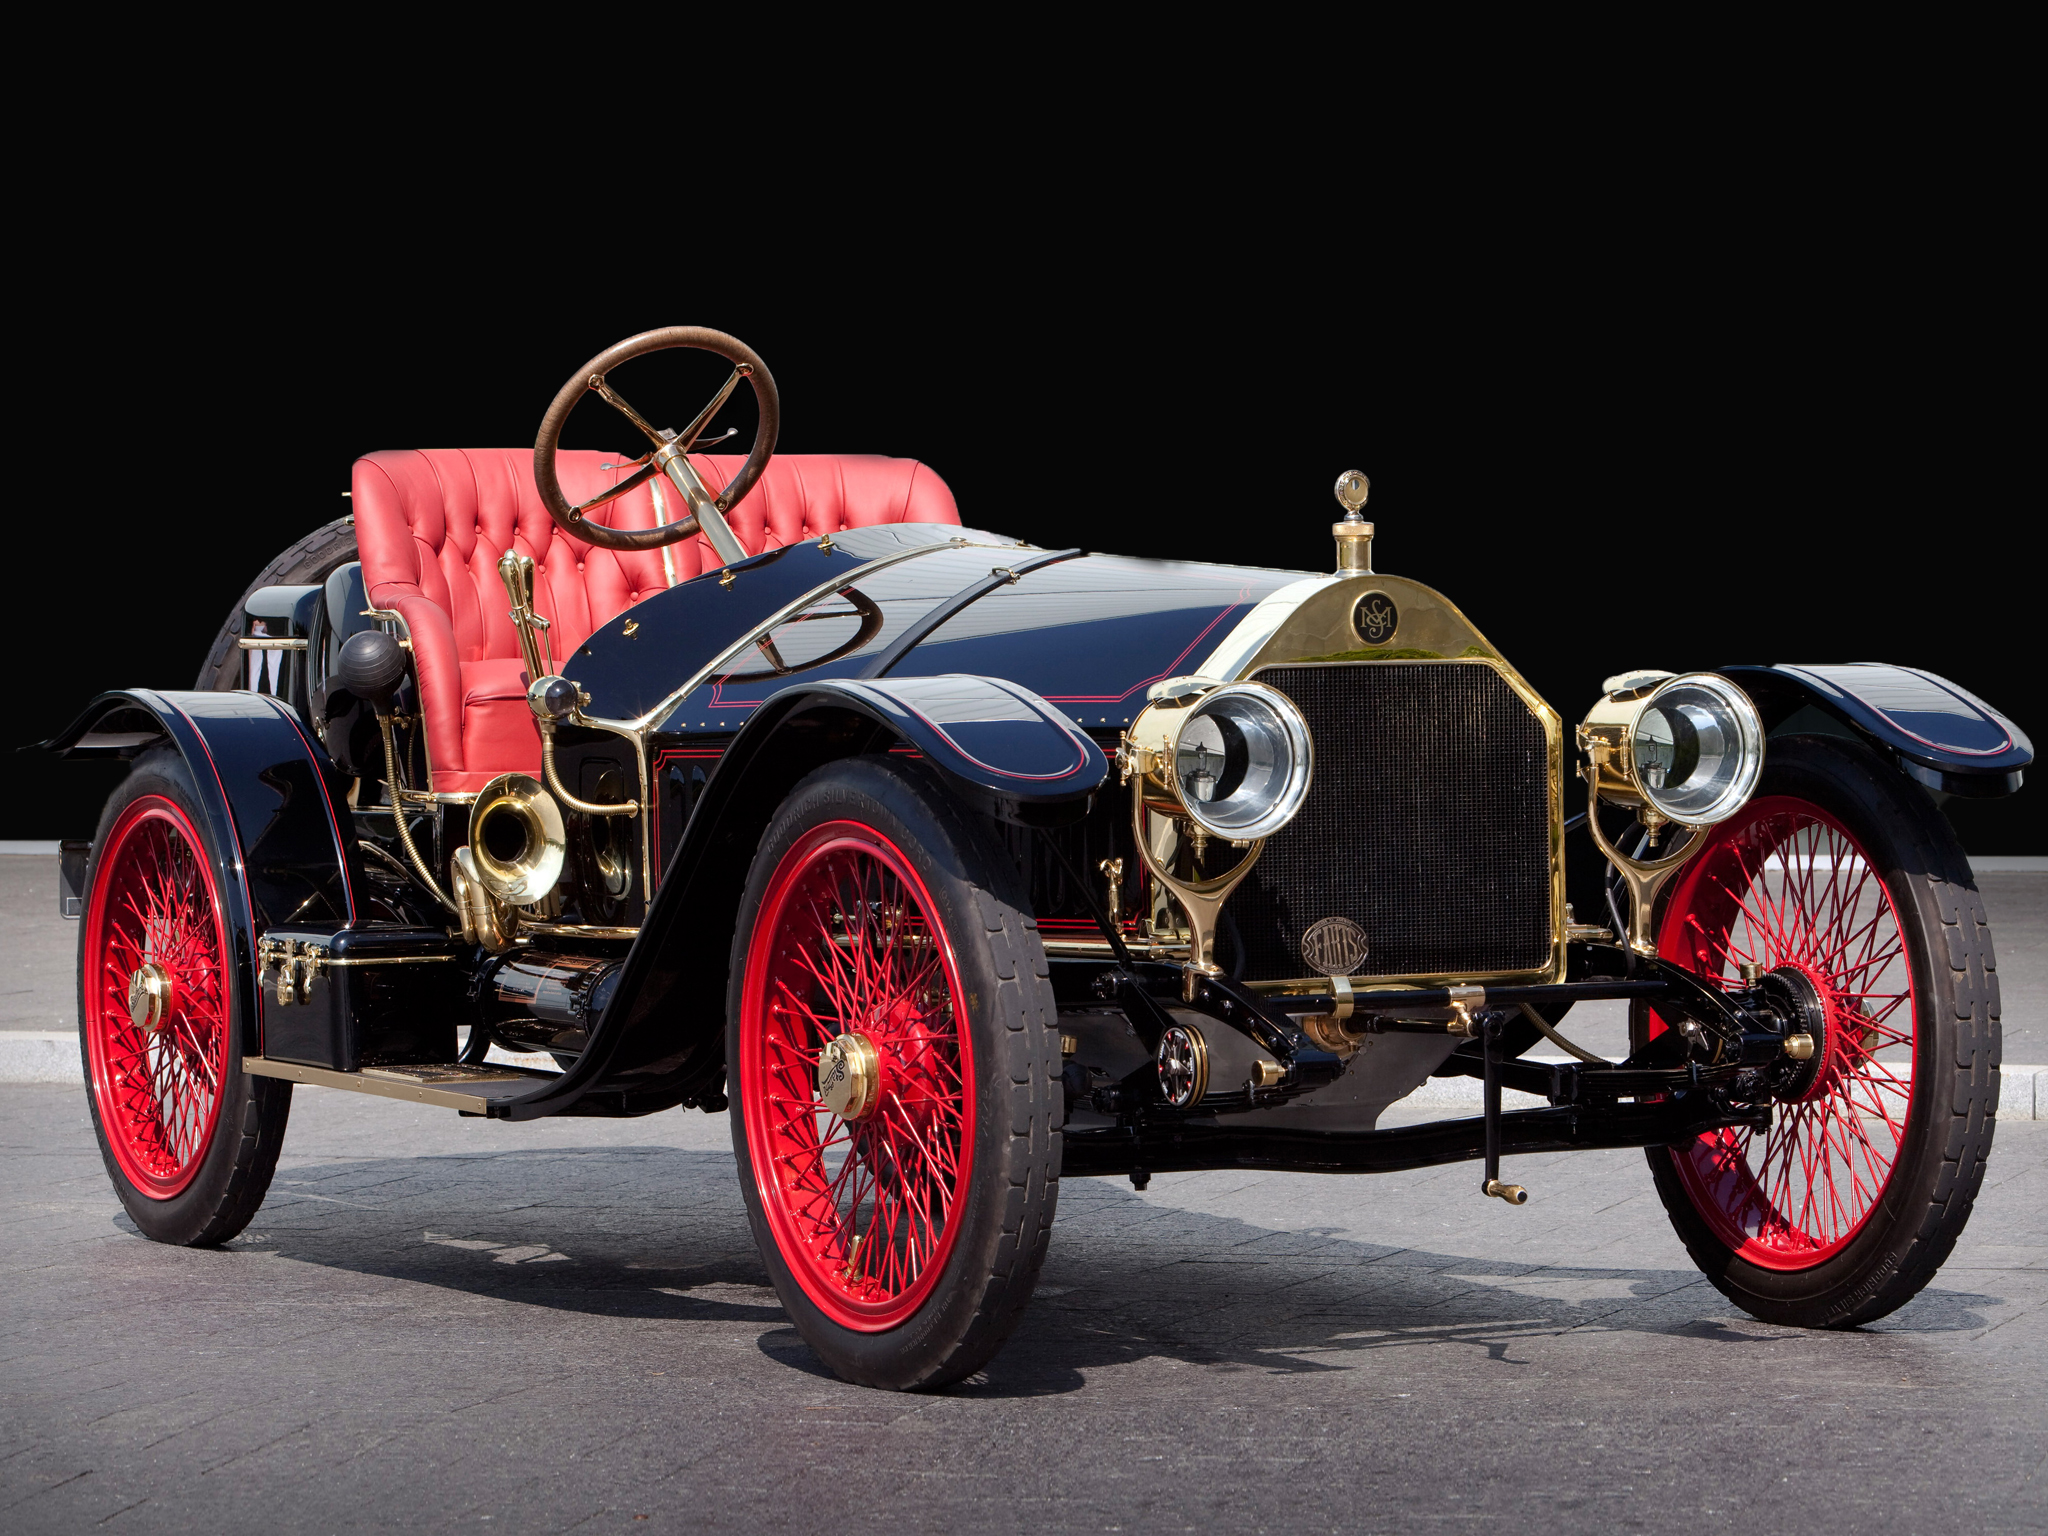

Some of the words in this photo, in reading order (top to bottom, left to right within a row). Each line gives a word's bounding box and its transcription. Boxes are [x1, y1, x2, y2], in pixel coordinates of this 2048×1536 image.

[766, 793, 820, 854] GOODRICH
[824, 789, 898, 827] SILVERTOWN
[900, 827, 933, 872] CORD
[1854, 1251, 1897, 1300] GOODRICH
